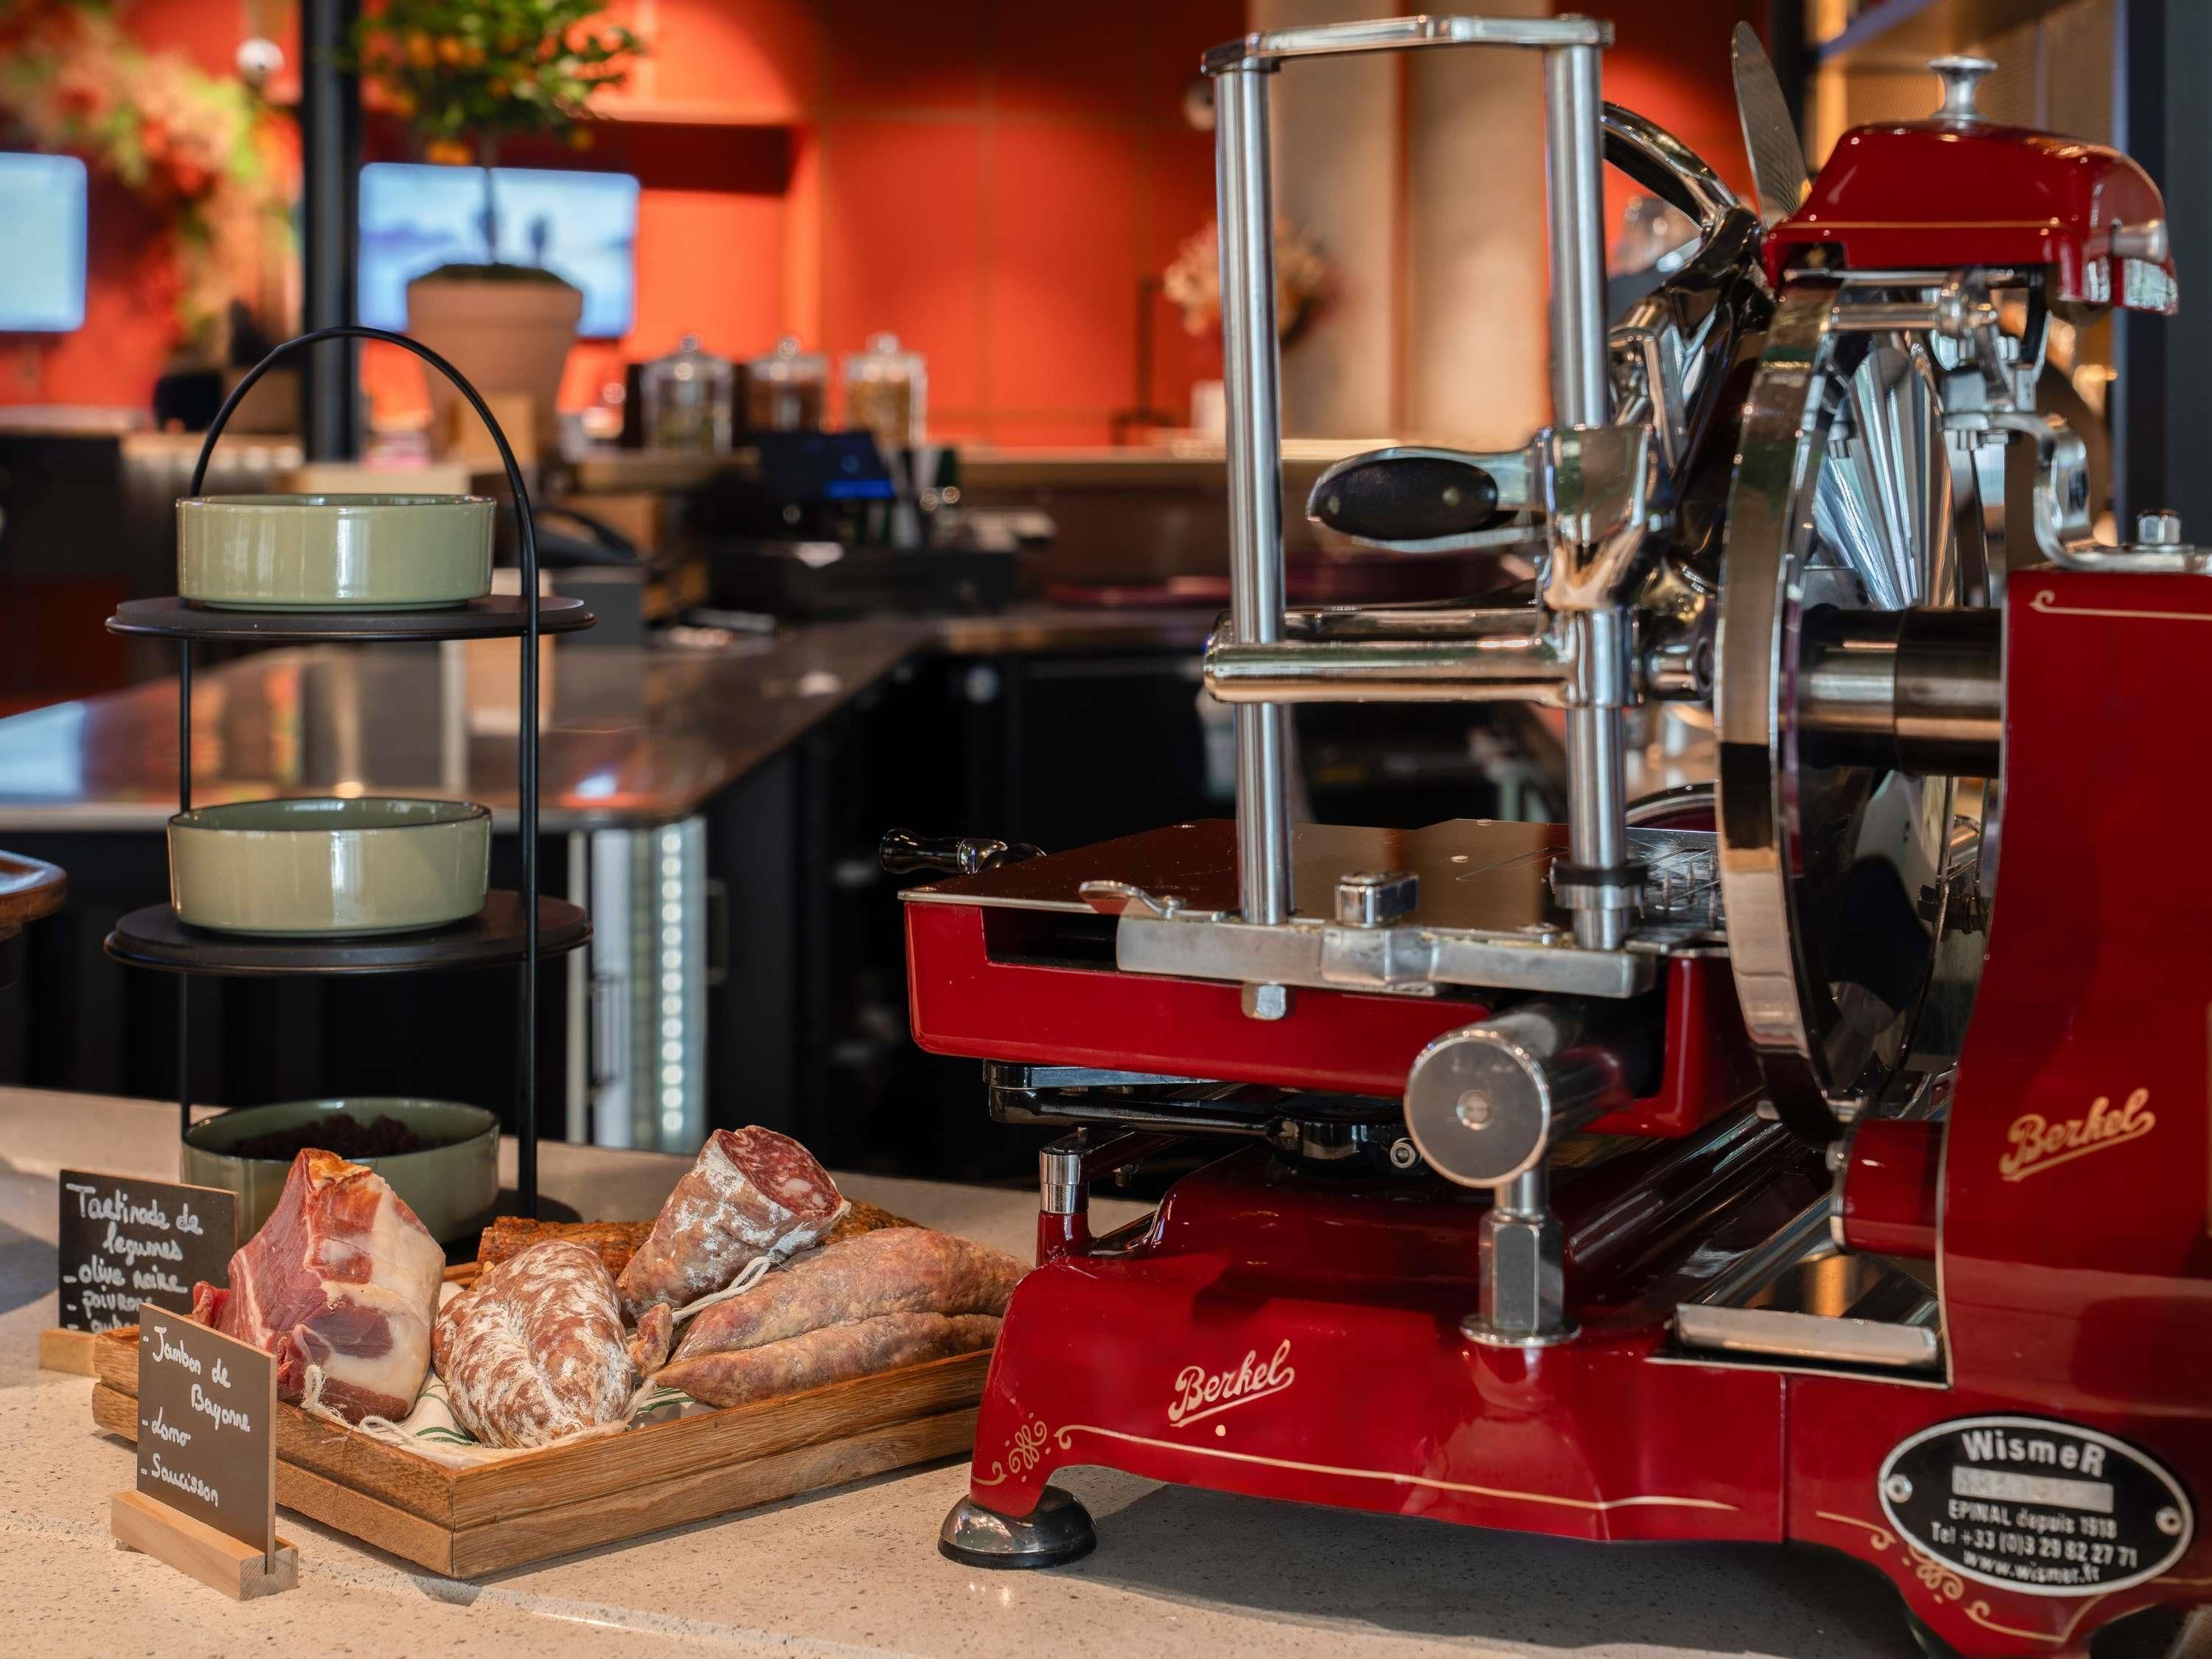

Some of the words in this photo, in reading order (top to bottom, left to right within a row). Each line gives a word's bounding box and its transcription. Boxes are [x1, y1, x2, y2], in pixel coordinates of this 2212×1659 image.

[1999, 1087, 2156, 1182] Berkel
[175, 1203, 204, 1235] de
[153, 1326, 201, 1375] Jambon
[212, 1357, 231, 1388] de
[1168, 1339, 1295, 1427] Berkel
[191, 1383, 250, 1433] Bayonne
[151, 1453, 219, 1507] Saucisson
[1948, 1498, 2011, 1526] EPINAL
[2016, 1506, 2076, 1534] depuis
[1930, 1521, 1957, 1545] Tel
[1961, 1528, 1996, 1550] +33
[2117, 1545, 2138, 1568] 71
